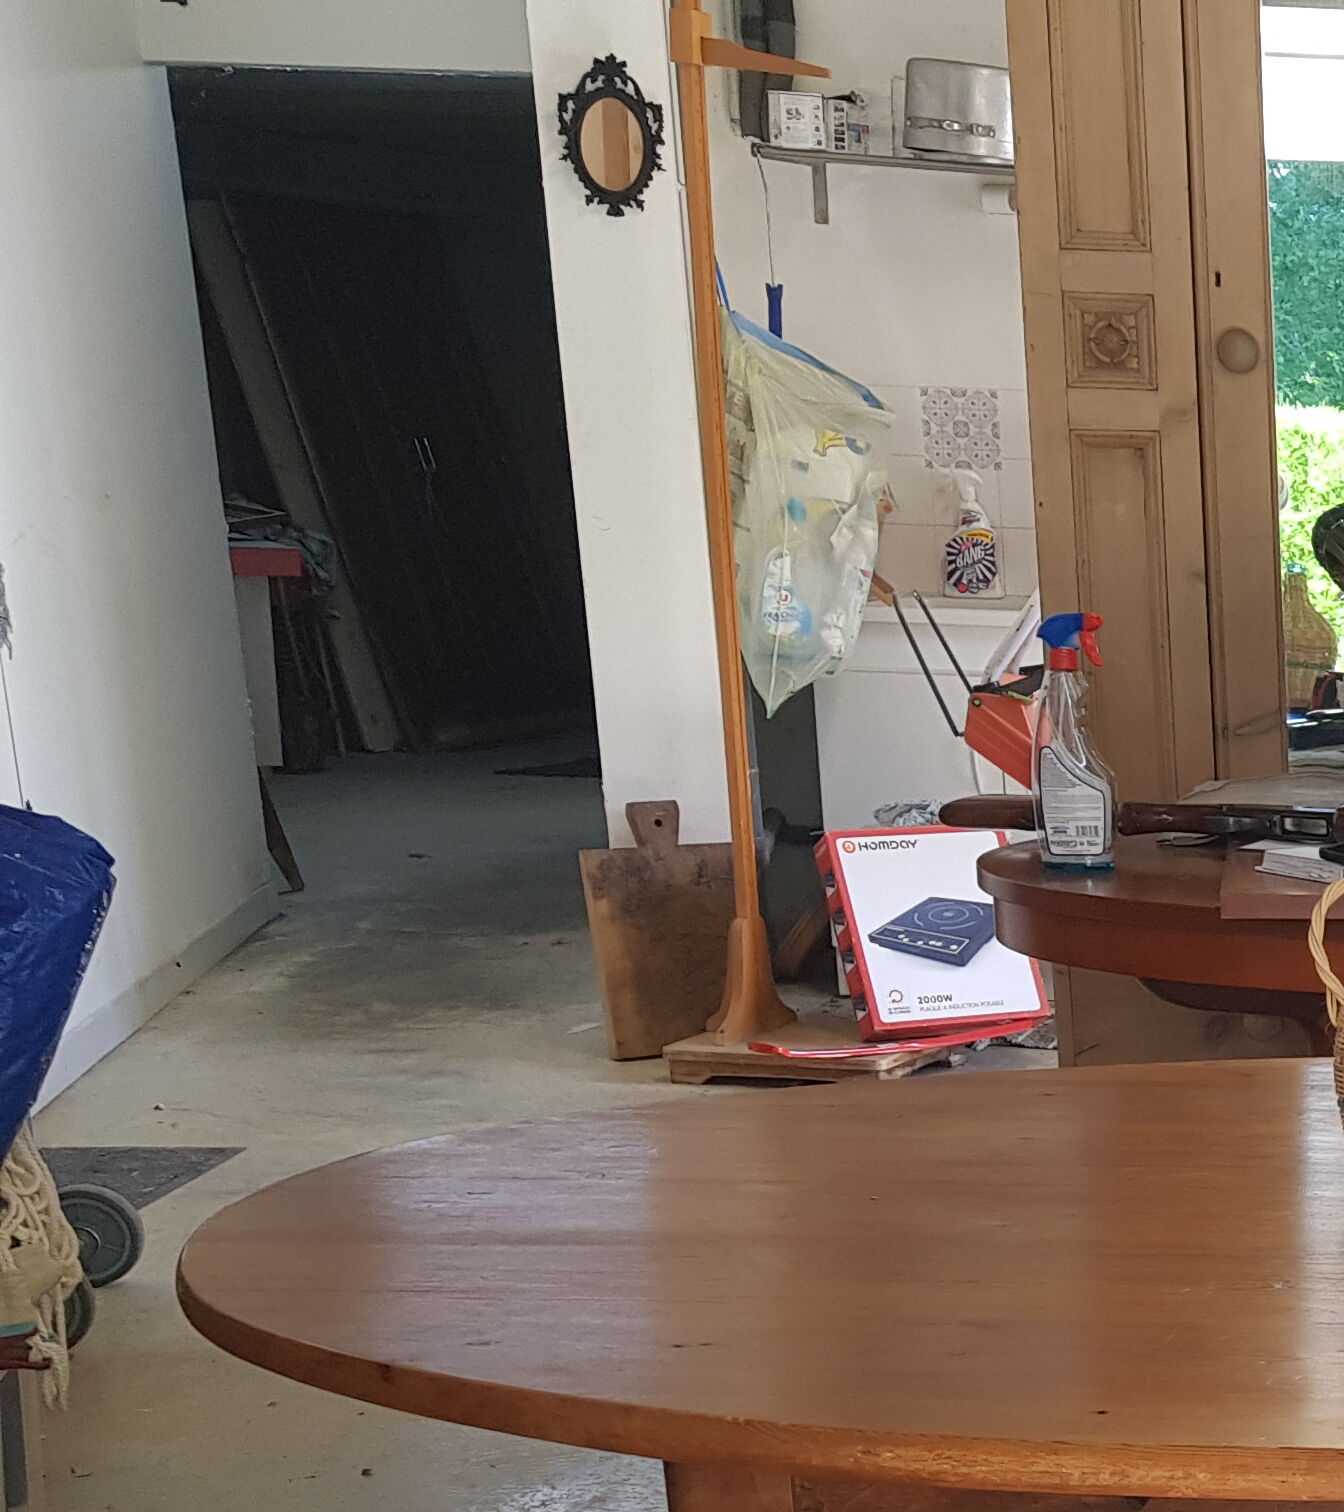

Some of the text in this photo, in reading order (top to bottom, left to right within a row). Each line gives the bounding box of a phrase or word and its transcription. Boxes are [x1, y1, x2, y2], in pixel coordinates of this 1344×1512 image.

[956, 546, 985, 568] BANG
[858, 840, 918, 851] HOMDAY
[917, 994, 953, 1005] 2000W
